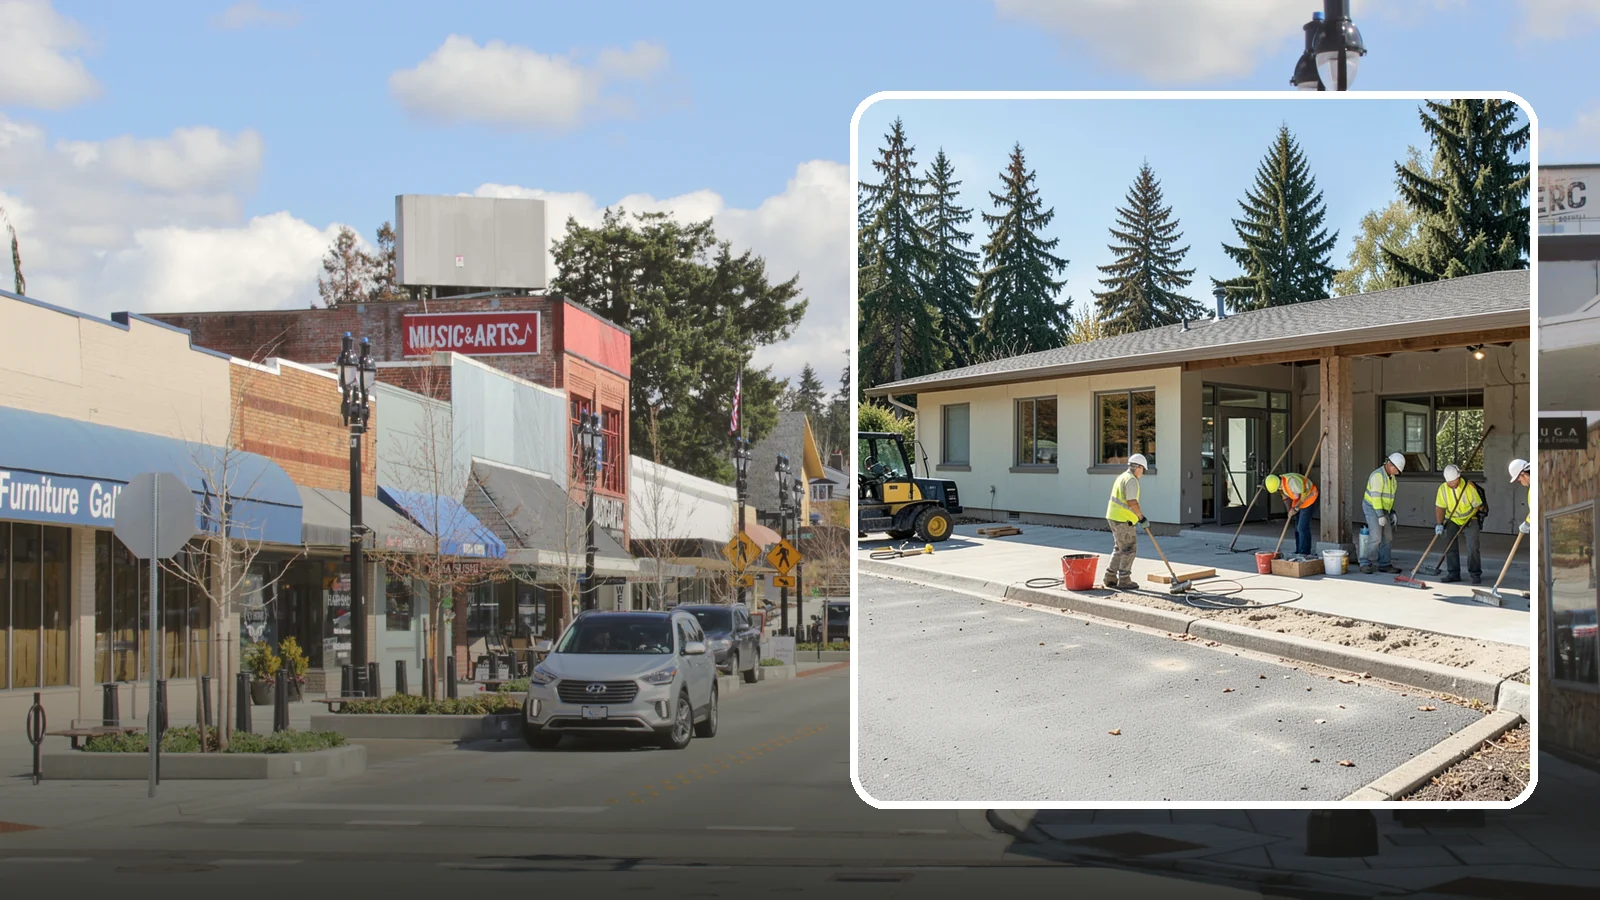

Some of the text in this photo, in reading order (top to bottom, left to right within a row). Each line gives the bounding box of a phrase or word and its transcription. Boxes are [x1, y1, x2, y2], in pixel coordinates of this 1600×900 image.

[0, 471, 122, 520] Furniture Gal
[453, 562, 480, 574] SUSHI
